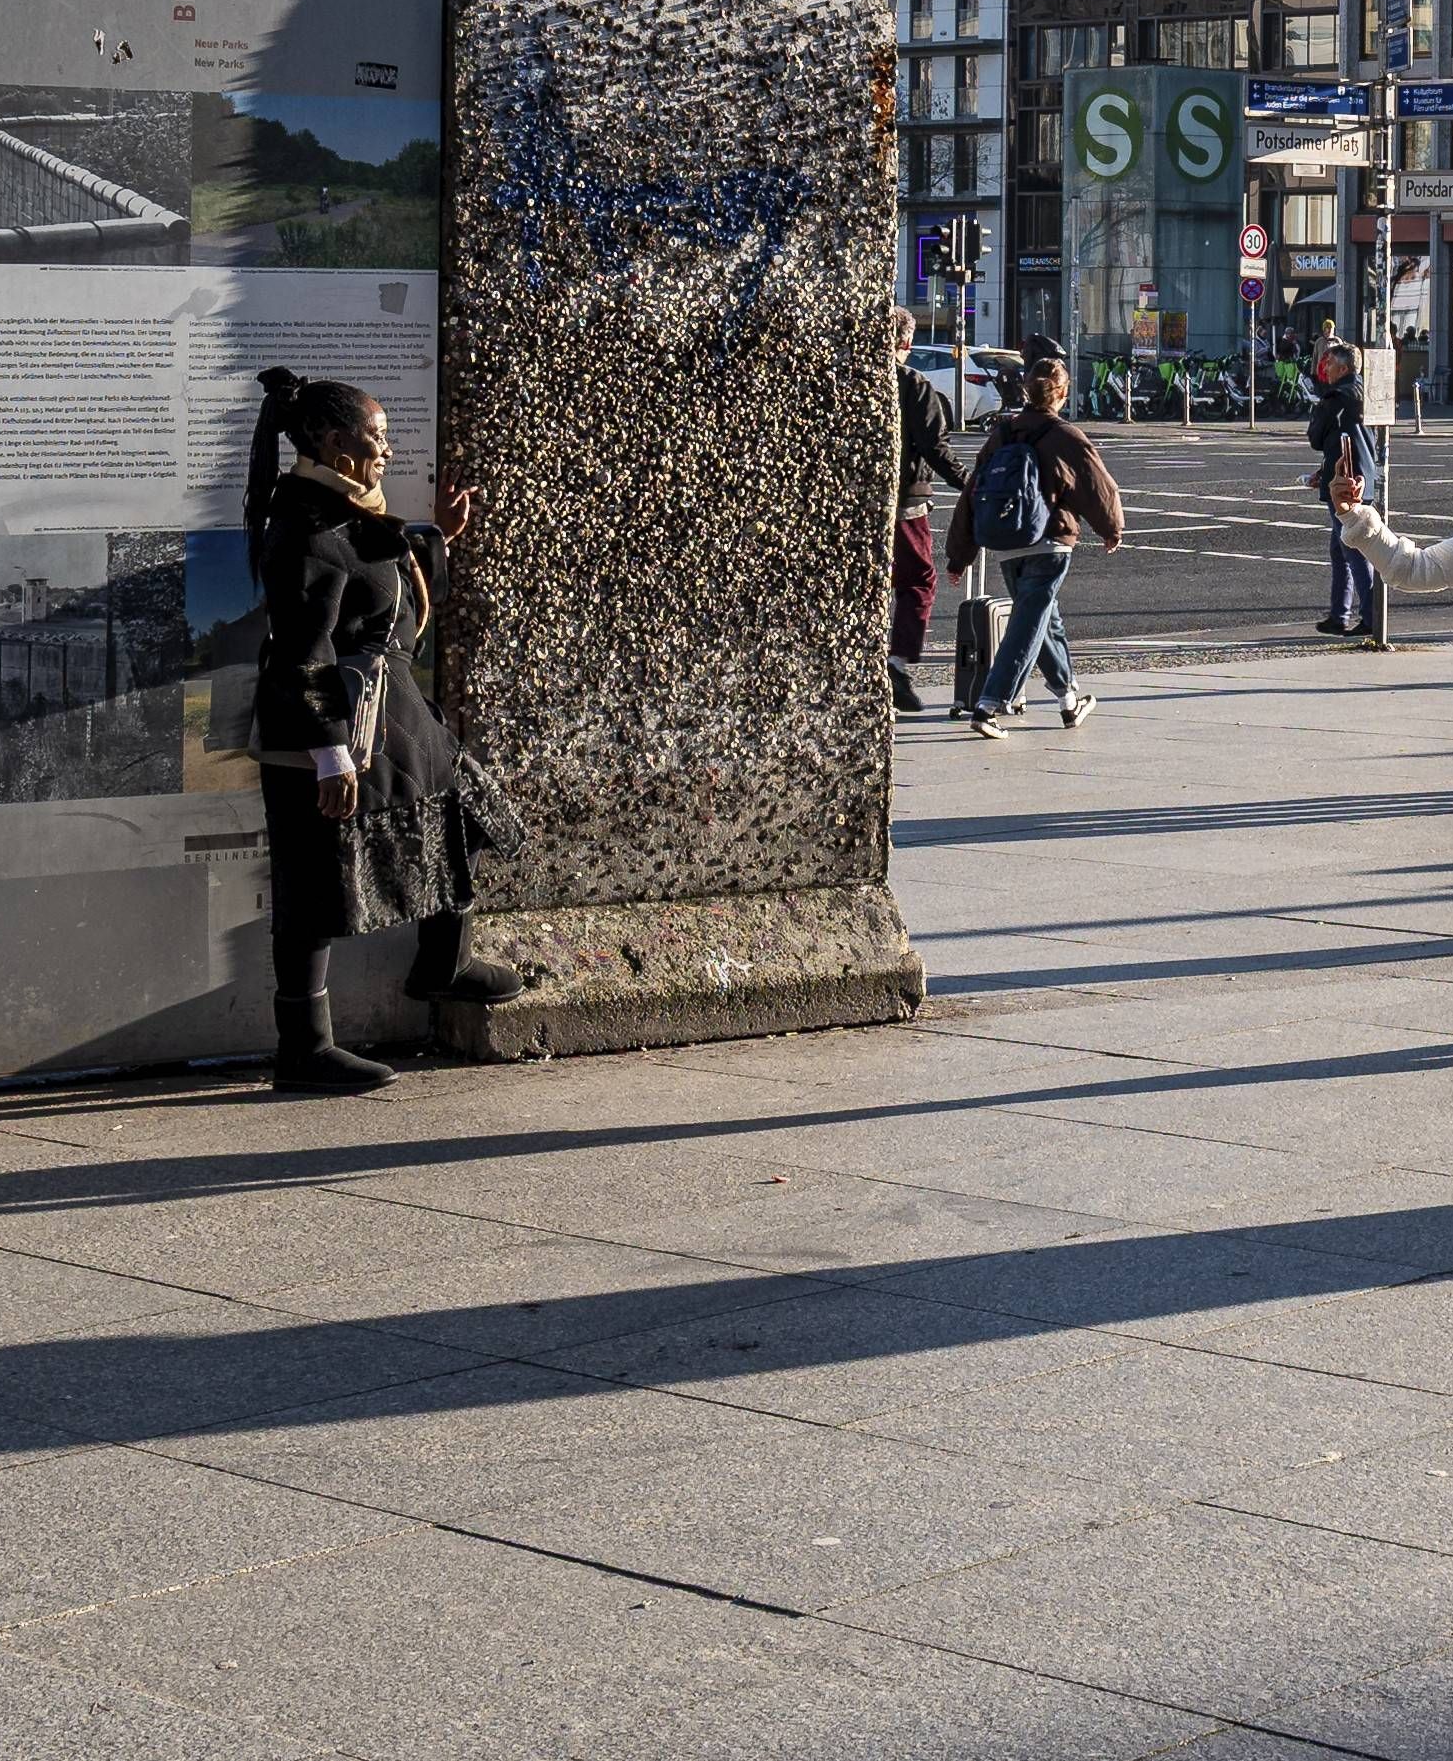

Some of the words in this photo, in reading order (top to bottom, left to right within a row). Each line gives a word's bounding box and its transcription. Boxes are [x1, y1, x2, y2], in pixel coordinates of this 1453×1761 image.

[194, 39, 219, 49] Neue
[223, 39, 248, 50] Parks
[194, 58, 214, 68] New
[218, 58, 244, 69] Parks
[1084, 92, 1132, 178] S
[1177, 93, 1222, 179] S
[1256, 130, 1327, 150] Potsdamer
[1331, 135, 1359, 154] Platz
[1246, 234, 1260, 249] 30
